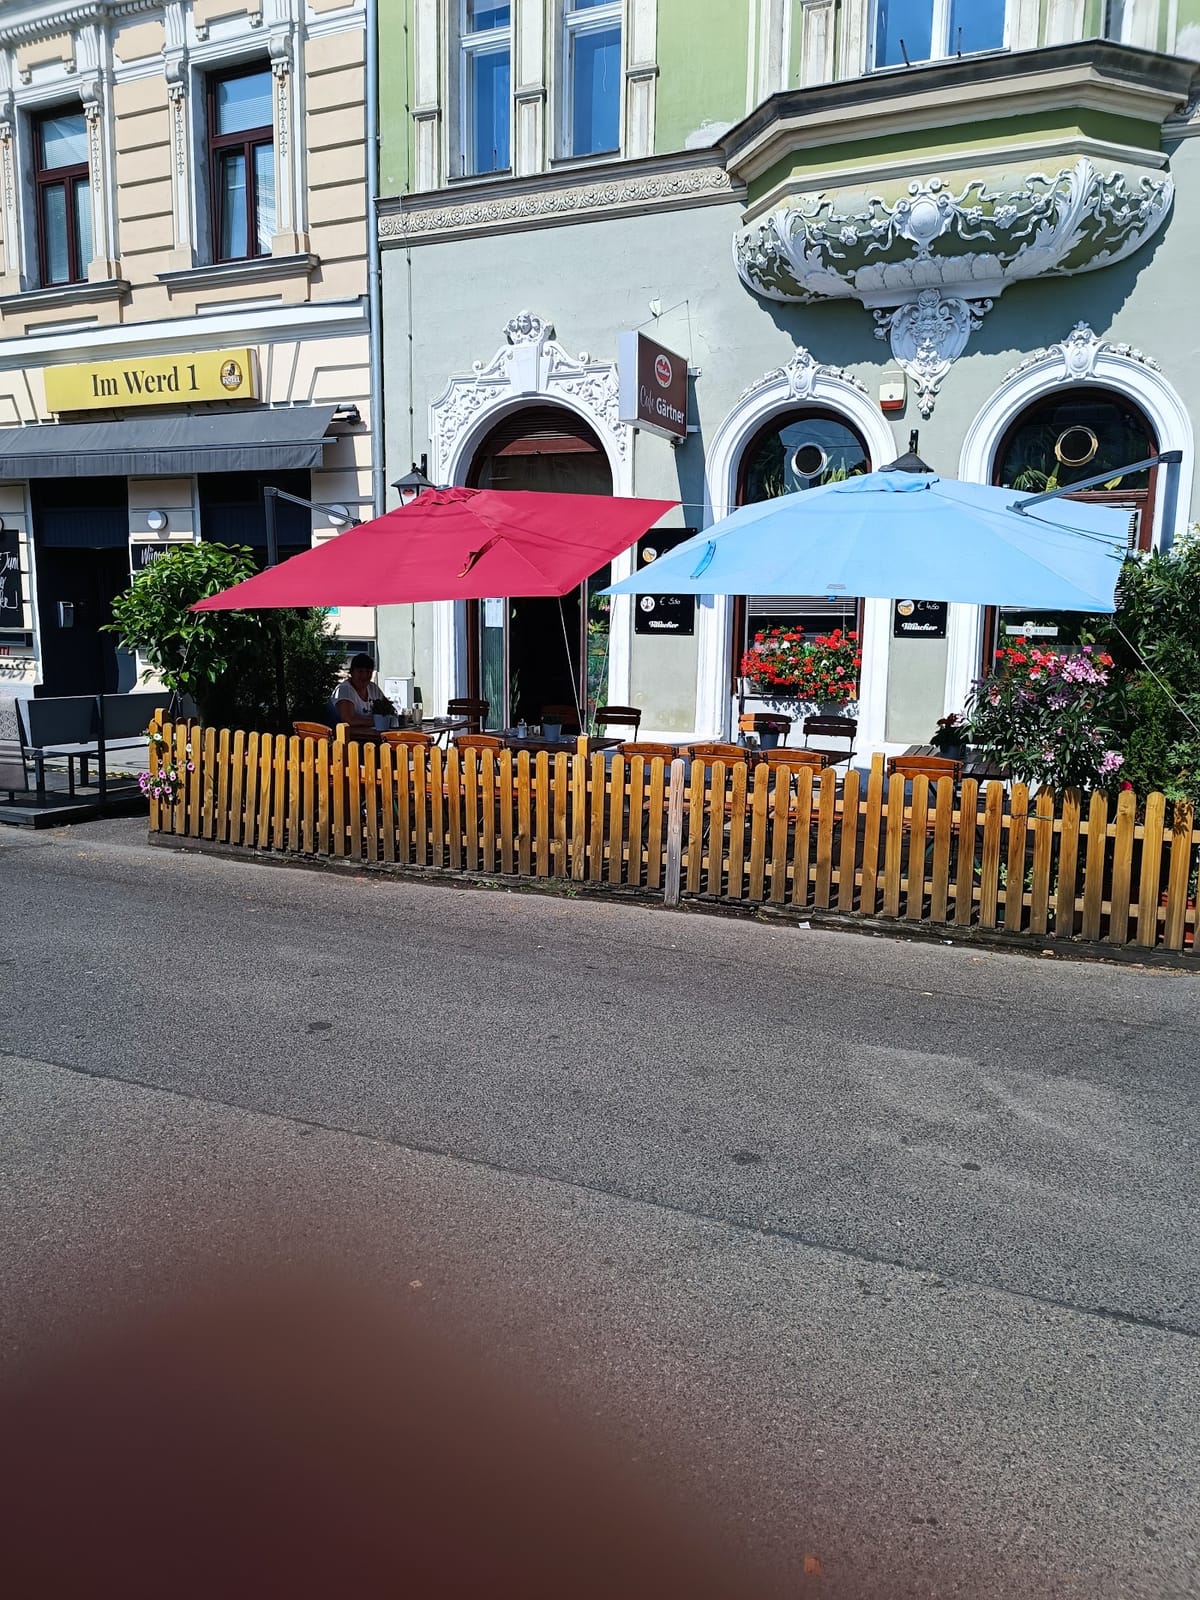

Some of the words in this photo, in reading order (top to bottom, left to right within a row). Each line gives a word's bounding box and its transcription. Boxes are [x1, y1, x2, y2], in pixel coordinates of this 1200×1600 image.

[91, 373, 119, 397] Im
[123, 365, 180, 394] Werd
[187, 363, 200, 391] 1
[656, 397, 685, 425] Gärtner
